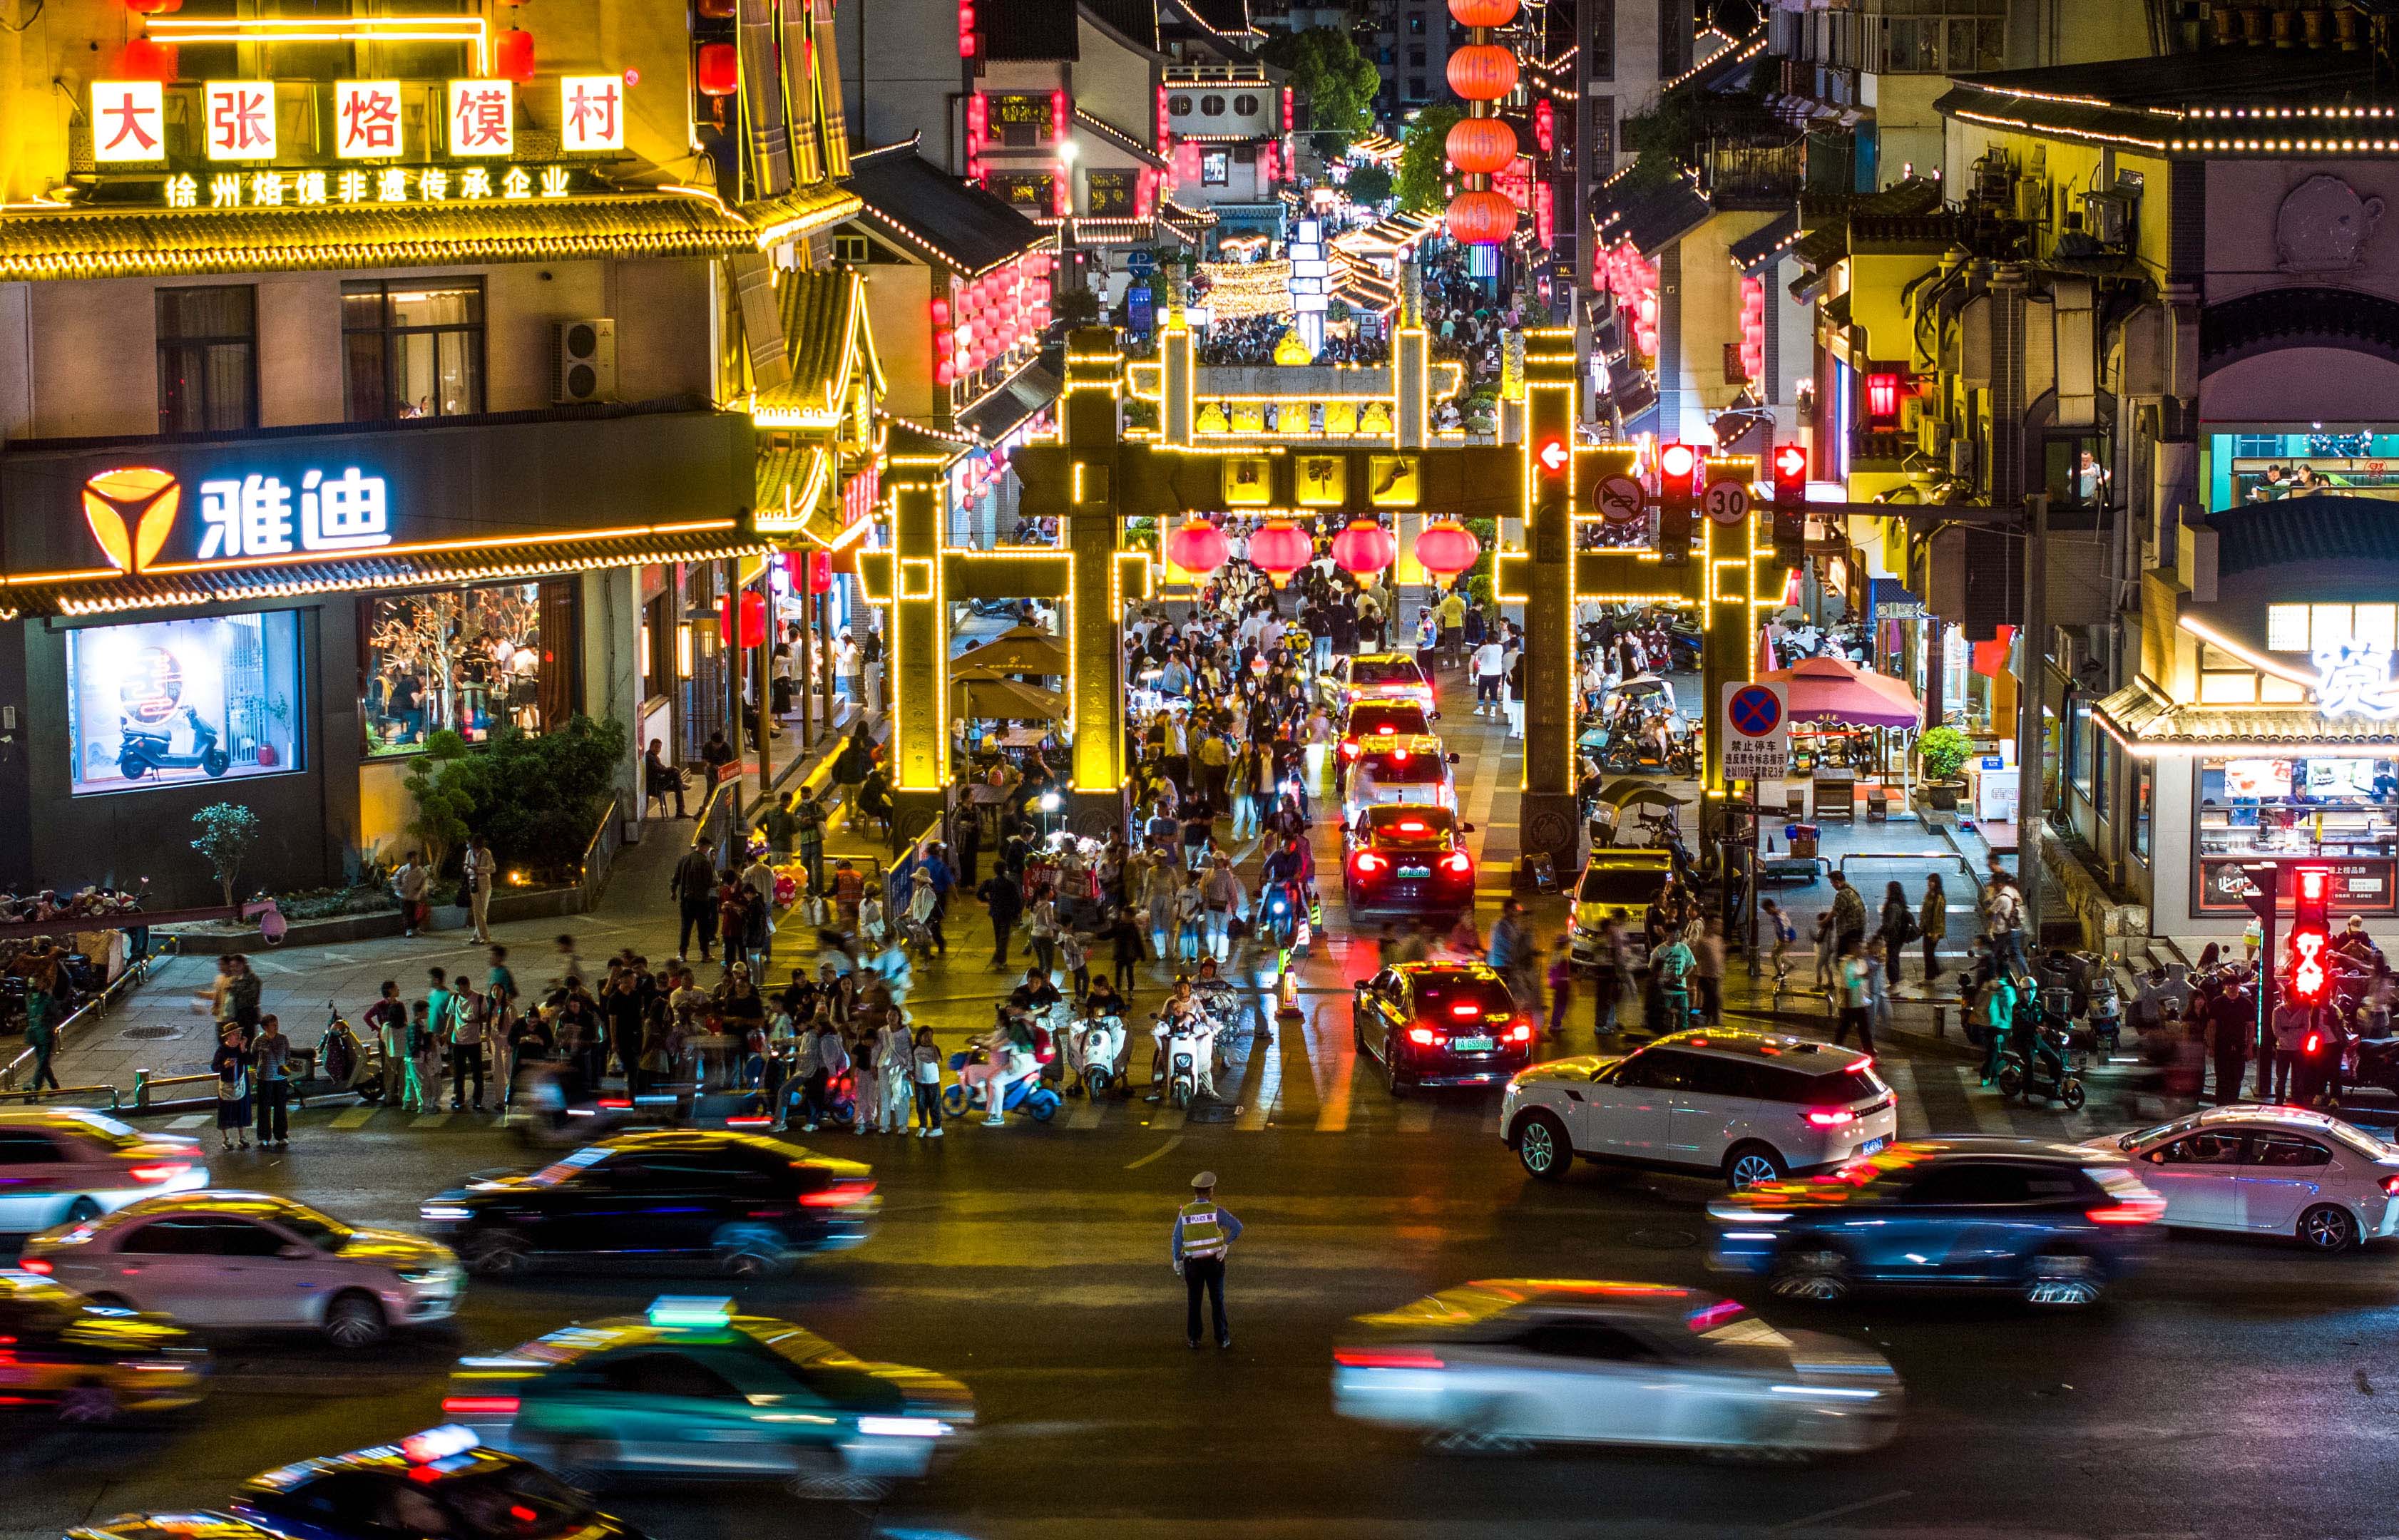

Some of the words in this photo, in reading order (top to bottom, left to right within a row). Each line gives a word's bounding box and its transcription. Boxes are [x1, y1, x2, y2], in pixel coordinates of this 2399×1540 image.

[102, 83, 618, 151] 大张烙馍村
[165, 165, 571, 208] 徐州烙馍非遗传承企业
[1137, 253, 1147, 264] P
[198, 467, 392, 560] 雅迪
[1712, 491, 1744, 515] 30
[1732, 741, 1777, 752] 禁止停车
[1725, 754, 1785, 764] 违反禁令标志指示
